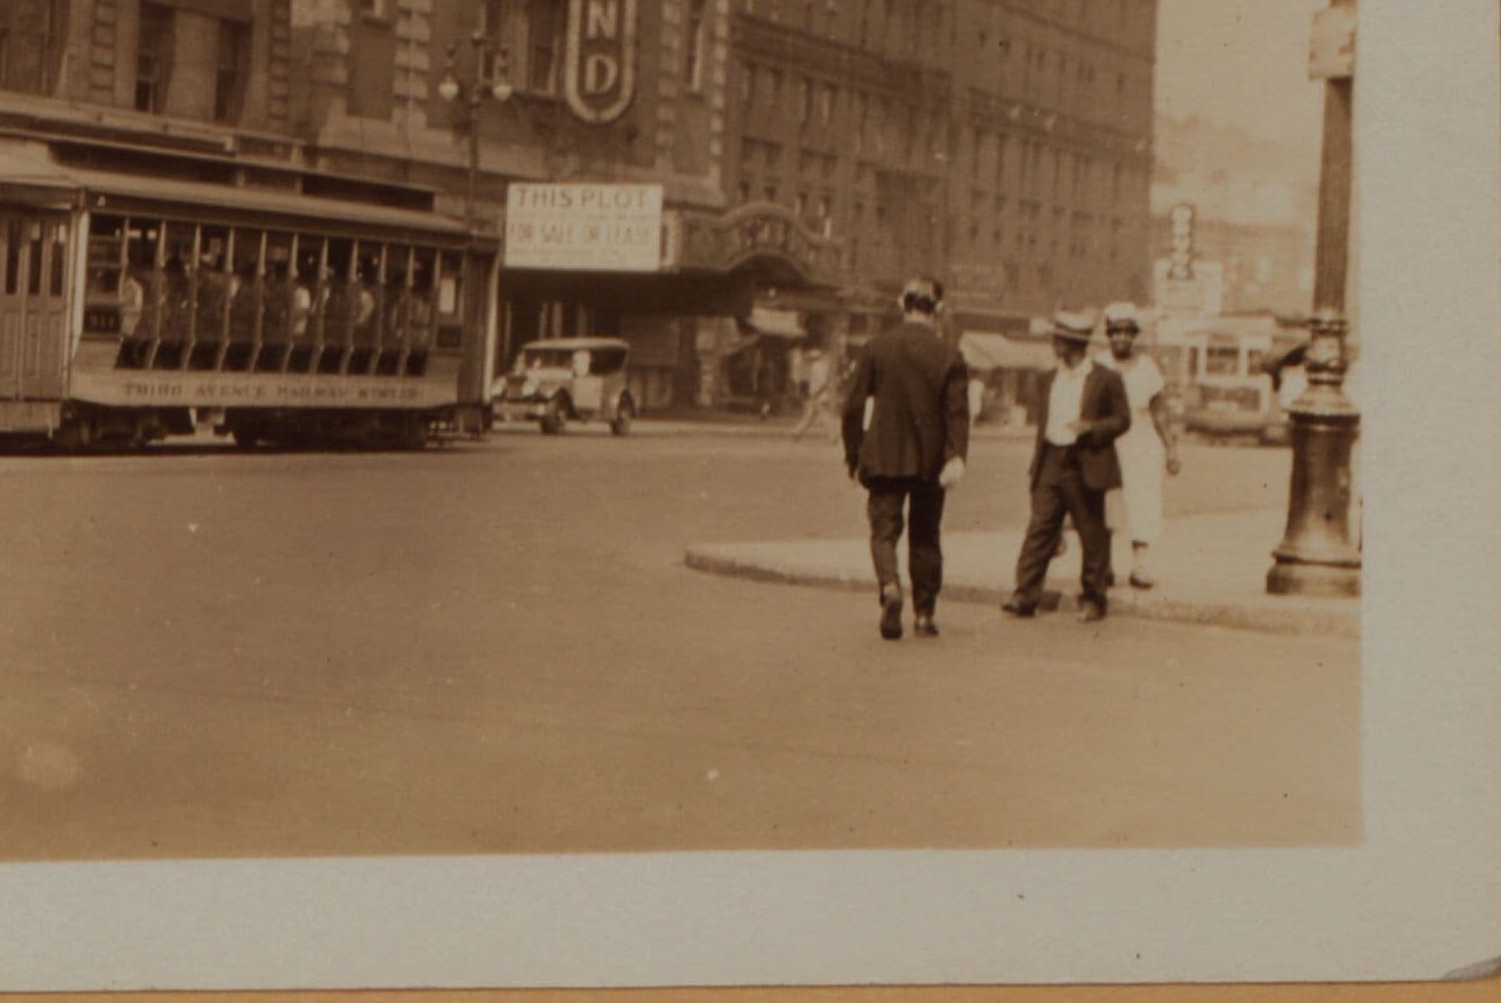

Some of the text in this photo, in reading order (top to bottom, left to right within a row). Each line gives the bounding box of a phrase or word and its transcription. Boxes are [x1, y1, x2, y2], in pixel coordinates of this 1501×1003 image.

[516, 186, 646, 210] THIS PLOT
[123, 382, 183, 398] THIRD
[195, 382, 266, 399] AVENUE
